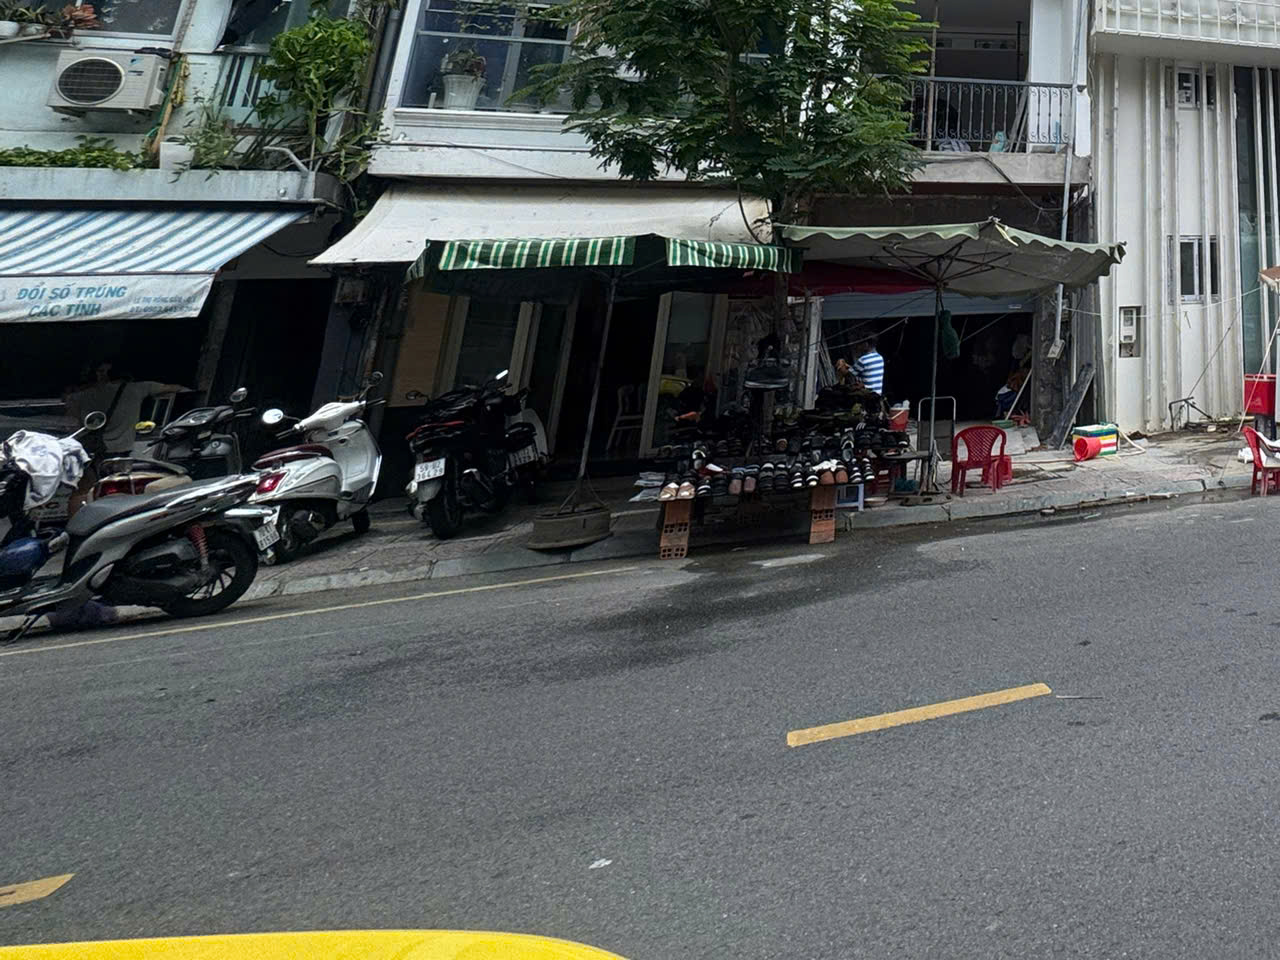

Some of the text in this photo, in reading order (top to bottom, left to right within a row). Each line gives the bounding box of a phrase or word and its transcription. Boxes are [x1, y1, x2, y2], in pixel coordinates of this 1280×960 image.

[50, 282, 73, 300] SỐ
[76, 284, 128, 299] TRÚNG
[28, 299, 102, 318] CÁC TỈNH
